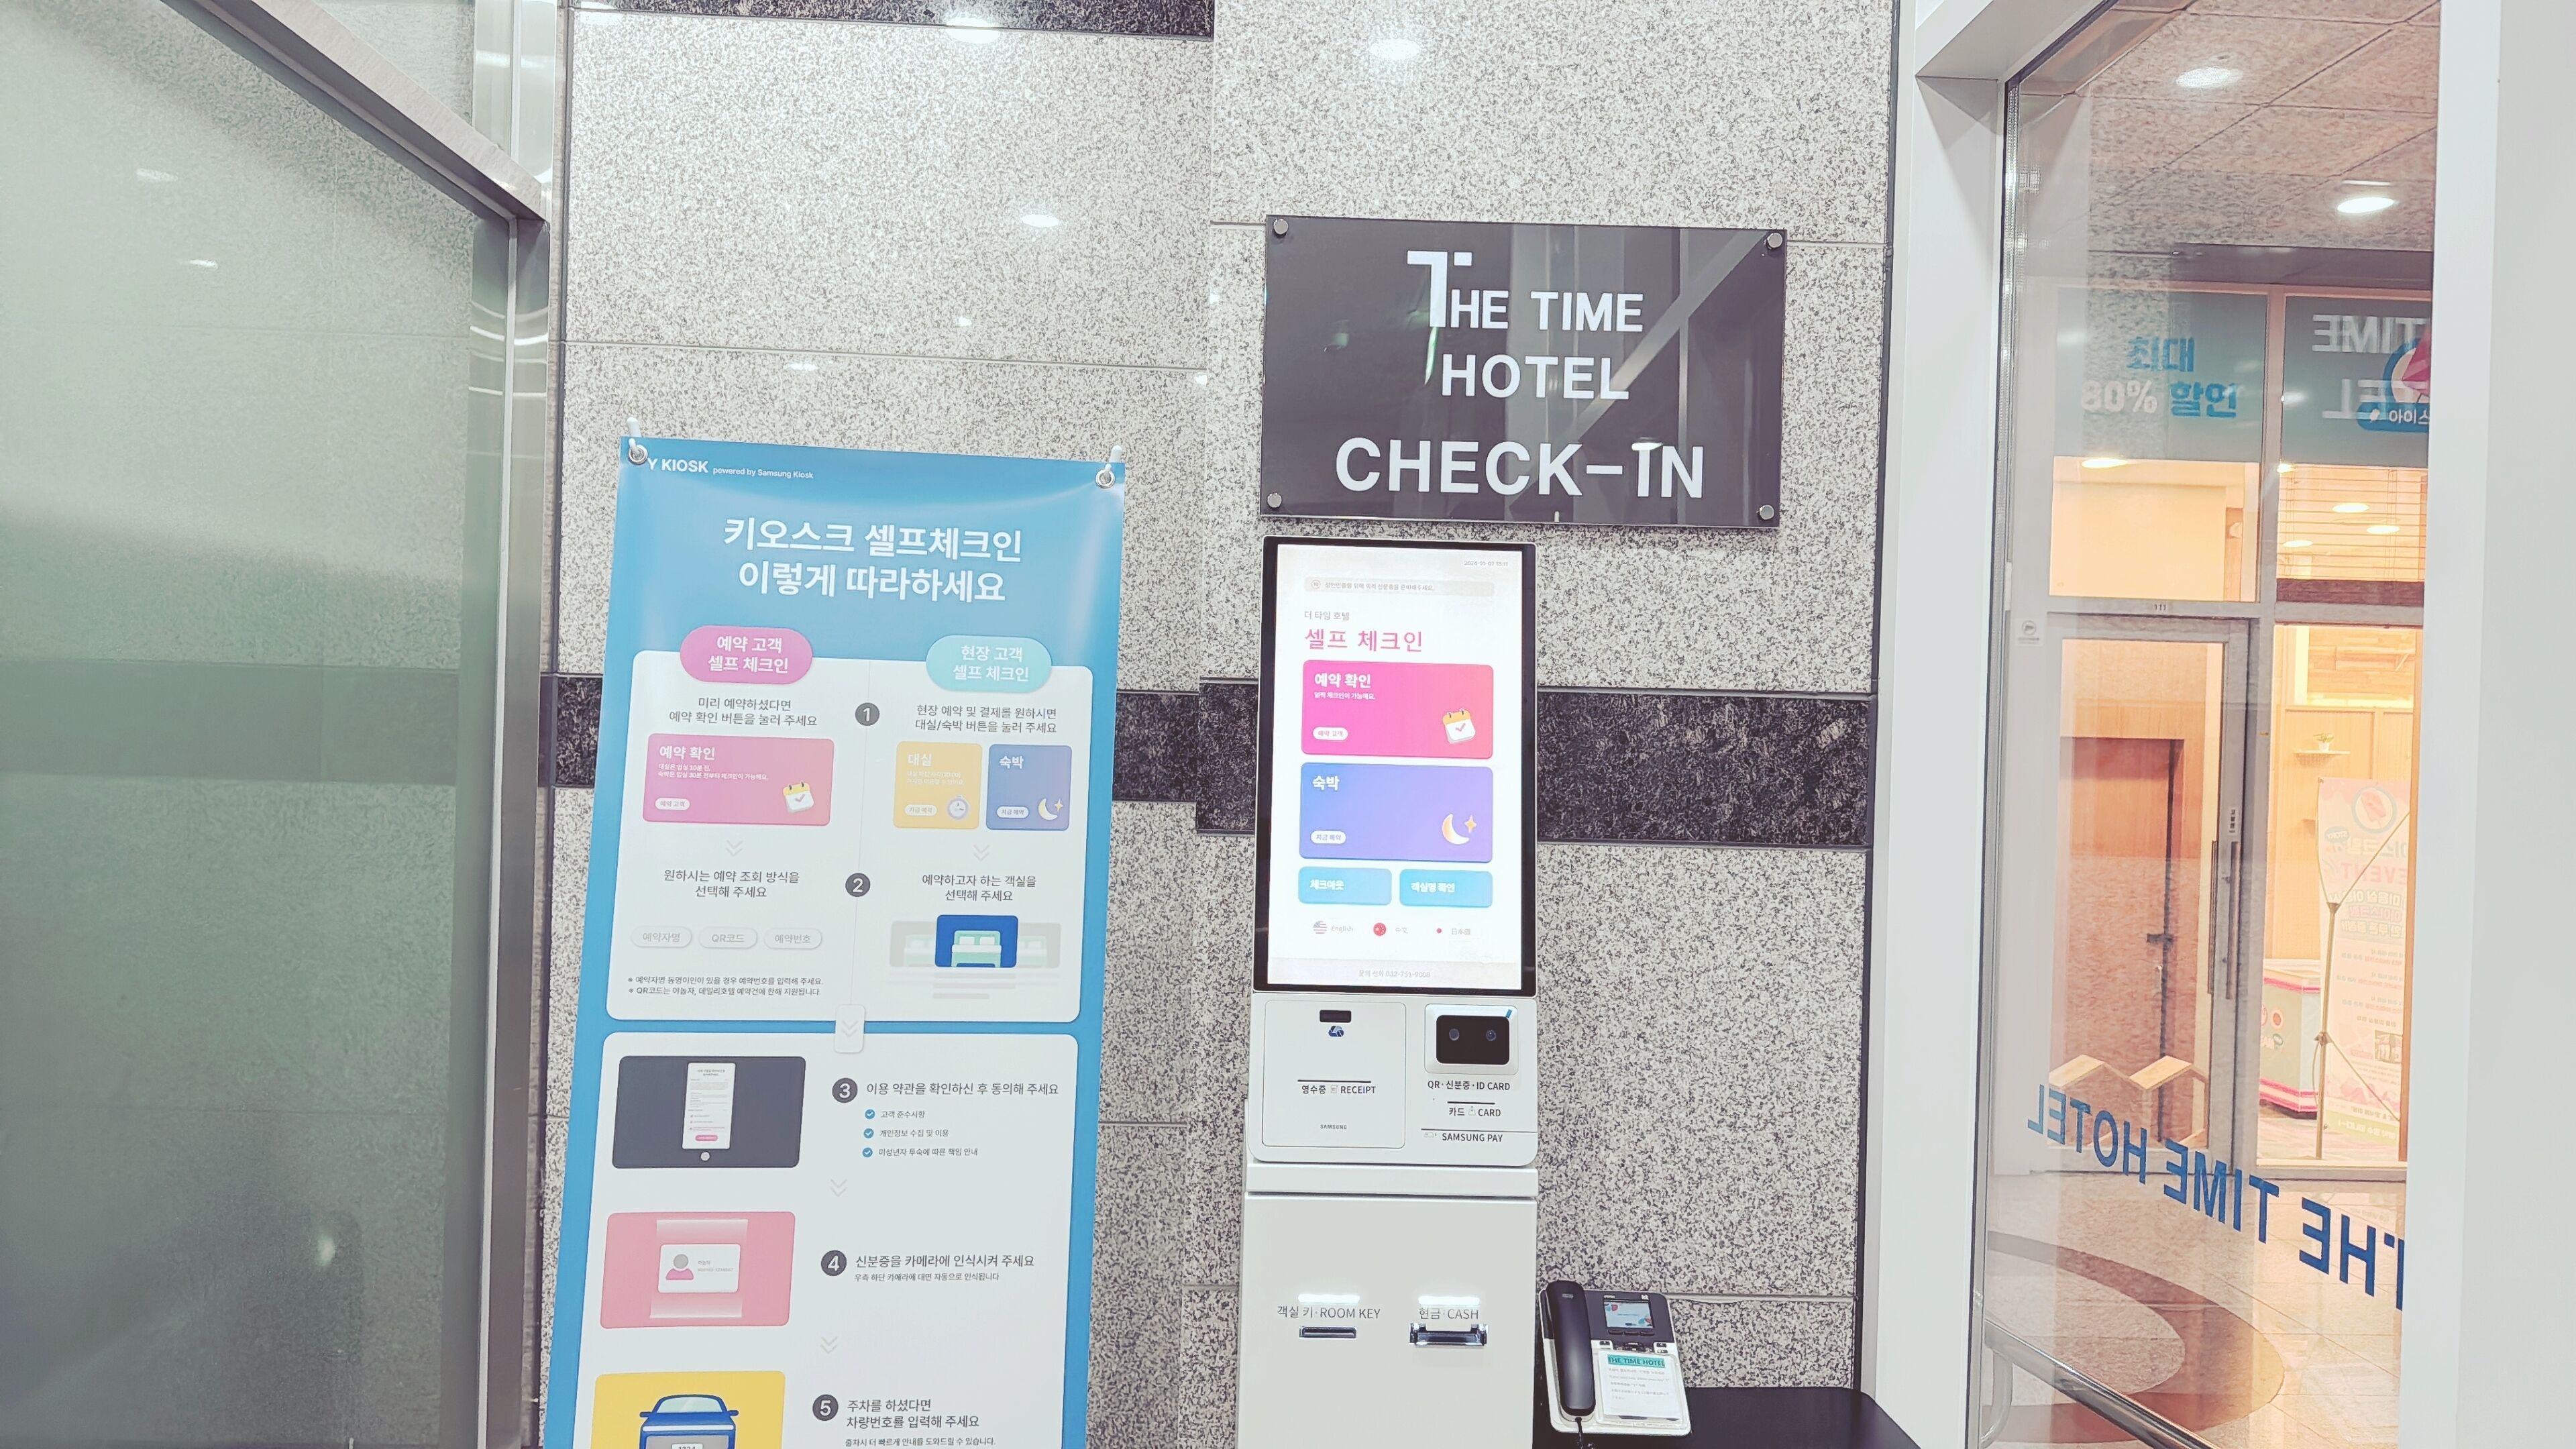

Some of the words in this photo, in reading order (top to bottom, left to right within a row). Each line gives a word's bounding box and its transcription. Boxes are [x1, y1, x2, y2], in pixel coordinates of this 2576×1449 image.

[1407, 250, 1509, 330] THE
[1530, 290, 1644, 333] TIME
[2127, 337, 2195, 372] 최대
[1441, 353, 1630, 401] HOTEL
[2081, 380, 2157, 413] 80%
[2170, 381, 2237, 417] 할인
[661, 459, 708, 473] KIOSK
[713, 467, 745, 475] powered
[747, 468, 755, 476] by
[757, 469, 791, 478] Samsung
[1335, 436, 1704, 499] CHECK-IN
[724, 517, 855, 551] 키오스크
[864, 525, 1021, 563] 셀프체크인
[739, 561, 835, 597] 이렇게
[847, 566, 1005, 602] 따라하세요
[1304, 611, 1312, 619] 더
[1314, 611, 1331, 620] 타임
[1333, 612, 1350, 621] 호텔
[717, 635, 748, 653] 예약
[751, 637, 782, 653] 고객
[1305, 629, 1348, 650] 셀프
[1358, 630, 1422, 653] 체크인
[961, 645, 990, 661] 현장
[995, 646, 1022, 662] 고객
[708, 655, 739, 672] 셀프
[743, 657, 788, 674] 체크인
[953, 665, 981, 681] 셀프
[985, 666, 1029, 682] 체크인
[1314, 673, 1341, 688] 예약
[1344, 673, 1371, 688] 확인
[698, 698, 720, 710] 미리
[724, 698, 791, 712] 예약하셨다면
[669, 711, 692, 723] 예약
[695, 711, 718, 724] 확인
[721, 712, 755, 725] 버튼을
[759, 714, 780, 726] 눌러
[784, 714, 818, 727] 주세요
[916, 705, 938, 716] 현장
[941, 706, 963, 717] 예약
[966, 706, 976, 718] 및
[979, 706, 1012, 718] 결제를
[1014, 707, 1057, 720] 원하시면
[915, 719, 963, 731] 대실/숙박
[966, 720, 998, 733] 버튼을
[1001, 721, 1022, 733] 눌러
[1025, 722, 1057, 734] 주세요
[659, 745, 686, 759] 예약
[689, 747, 715, 761] 확인
[908, 753, 932, 767] 대실
[999, 755, 1024, 769] 숙박
[1312, 775, 1340, 791] 숙박
[664, 870, 710, 882] 원하시는
[714, 870, 737, 882] 예약
[739, 871, 761, 883] 조회
[766, 871, 800, 883] 방식을
[922, 874, 977, 886] 예약하고자
[980, 875, 1001, 887] 하는
[1004, 875, 1036, 888] 객실을
[695, 886, 729, 898] 선택해
[733, 886, 767, 898] 주세요
[1309, 879, 1344, 892] 체크아웃
[1438, 882, 1455, 894] 확인
[945, 890, 977, 902] 선택해
[981, 891, 1012, 902] 주세요
[1331, 924, 1353, 933] English
[643, 932, 681, 943] 예약자명
[712, 933, 745, 943] QR코드
[775, 934, 811, 944] 예약번호
[668, 977, 704, 985] 동명이인이
[739, 977, 774, 985] 예약번호를
[637, 987, 670, 996] QR코드는
[867, 1083, 889, 1095] 이용
[892, 1083, 926, 1095] 약관을
[929, 1083, 973, 1095] 확인하신
[977, 1083, 988, 1095] 후
[991, 1083, 1024, 1095] 동의해
[1026, 1083, 1059, 1095] 주세요
[1301, 1085, 1326, 1095] 영수증
[1340, 1085, 1377, 1095] RECEIPT
[1487, 1082, 1511, 1091] CARD
[881, 1110, 895, 1118] 고객
[1448, 1107, 1465, 1117] 카드
[1478, 1108, 1501, 1117] CARD
[1442, 1133, 1485, 1142] SAMSUNG
[1487, 1134, 1503, 1142] PAY
[879, 1148, 906, 1157] 미성년자
[909, 1148, 930, 1157] 투숙에
[932, 1148, 946, 1157] 따른
[948, 1148, 961, 1157] 책임
[964, 1148, 977, 1157] 안내
[856, 1255, 902, 1268] 신분증을
[905, 1255, 950, 1267] 카메라에
[953, 1254, 998, 1267] 인식시켜
[1001, 1254, 1035, 1267] 주세요
[854, 1273, 869, 1281] 우측
[871, 1273, 885, 1281] 하단
[887, 1273, 916, 1281] 카메라에
[934, 1273, 963, 1281] 자동으로
[1277, 1305, 1299, 1319] 객실
[1359, 1308, 1381, 1319] KEY
[847, 1399, 881, 1412] 주차를
[885, 1399, 931, 1412] 하셨다면
[847, 1416, 904, 1430] 차량번호를
[908, 1416, 942, 1428] 입력해
[945, 1416, 979, 1428] 주세요
[878, 1438, 900, 1446] 빠르게
[902, 1438, 923, 1446] 안내를
[925, 1438, 954, 1446] 도와드릴
